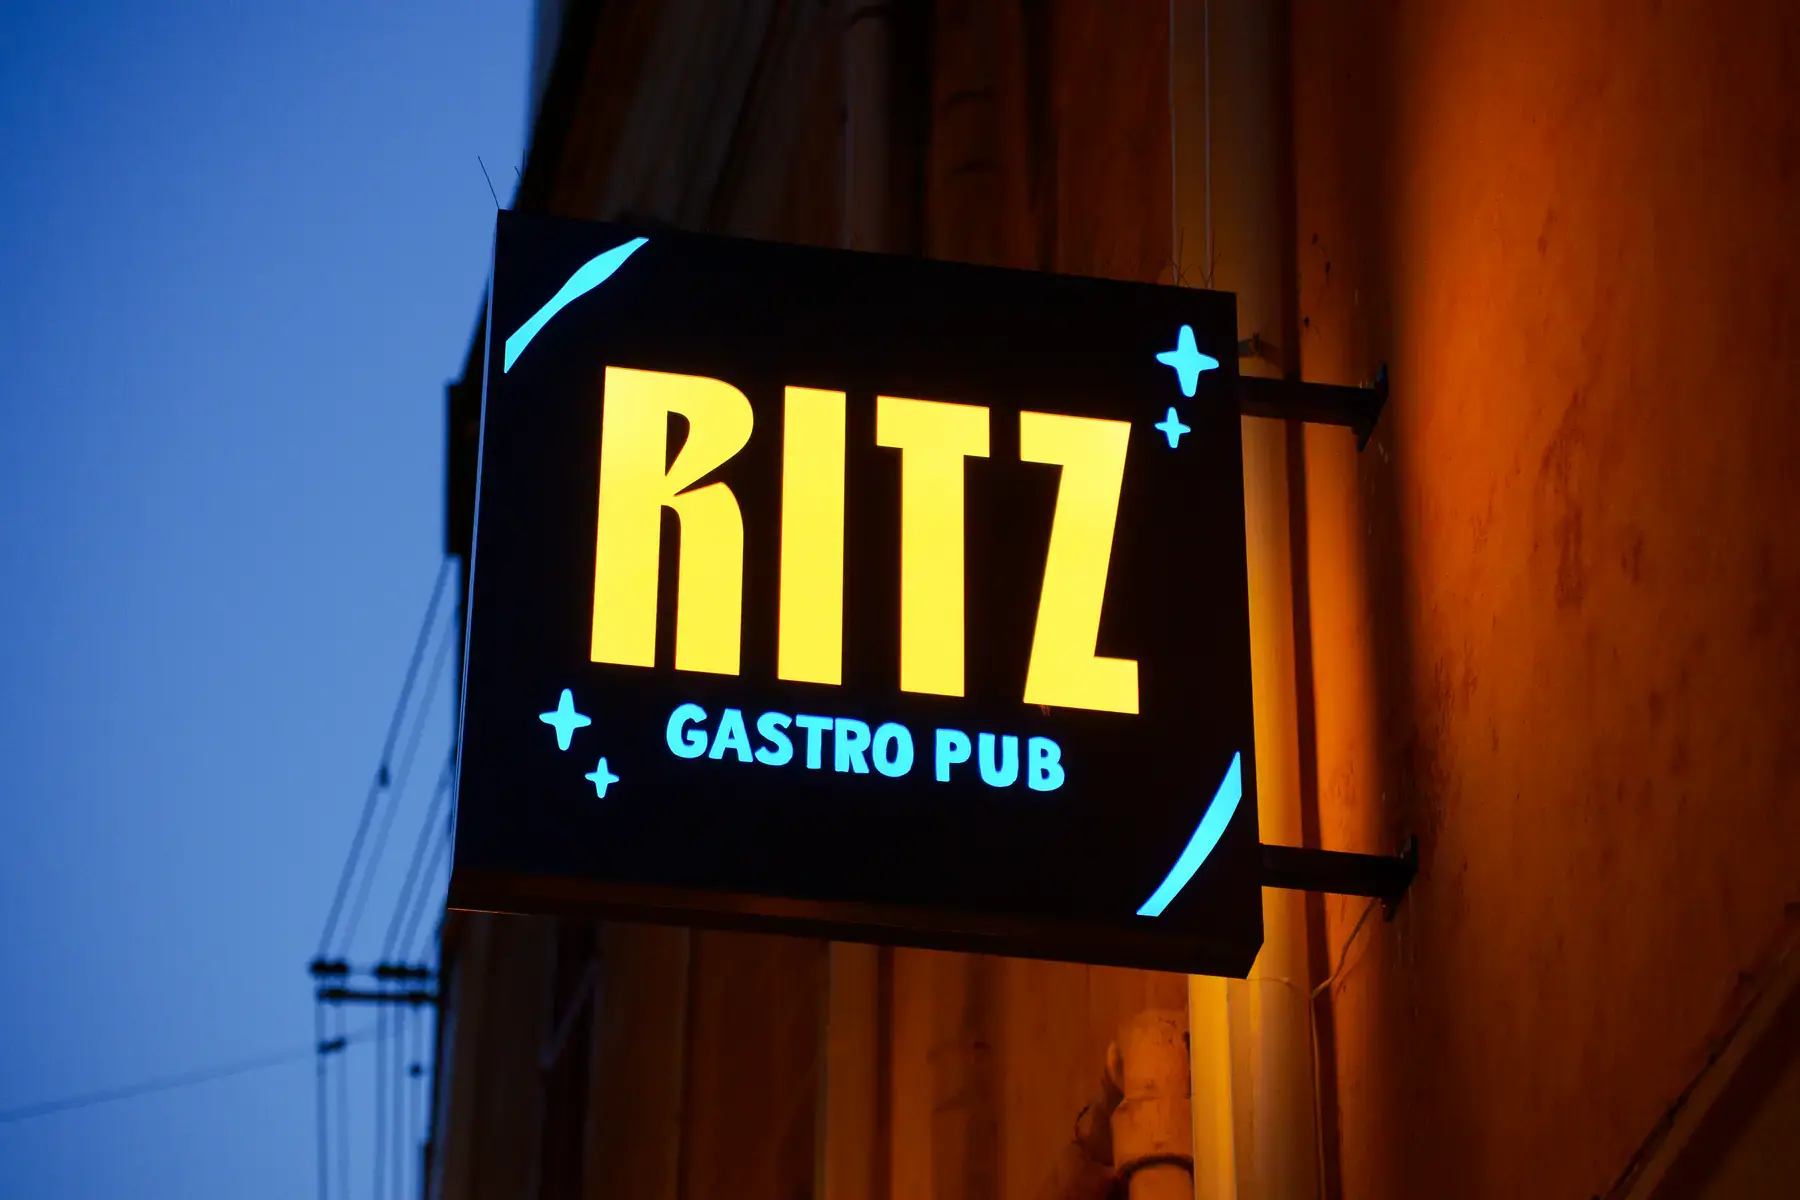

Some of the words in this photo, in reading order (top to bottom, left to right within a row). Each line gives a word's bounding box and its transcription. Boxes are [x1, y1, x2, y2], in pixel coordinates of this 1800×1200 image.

[590, 365, 1140, 715] RITZ
[665, 703, 915, 778] GASTRO
[934, 728, 1067, 793] PUB
